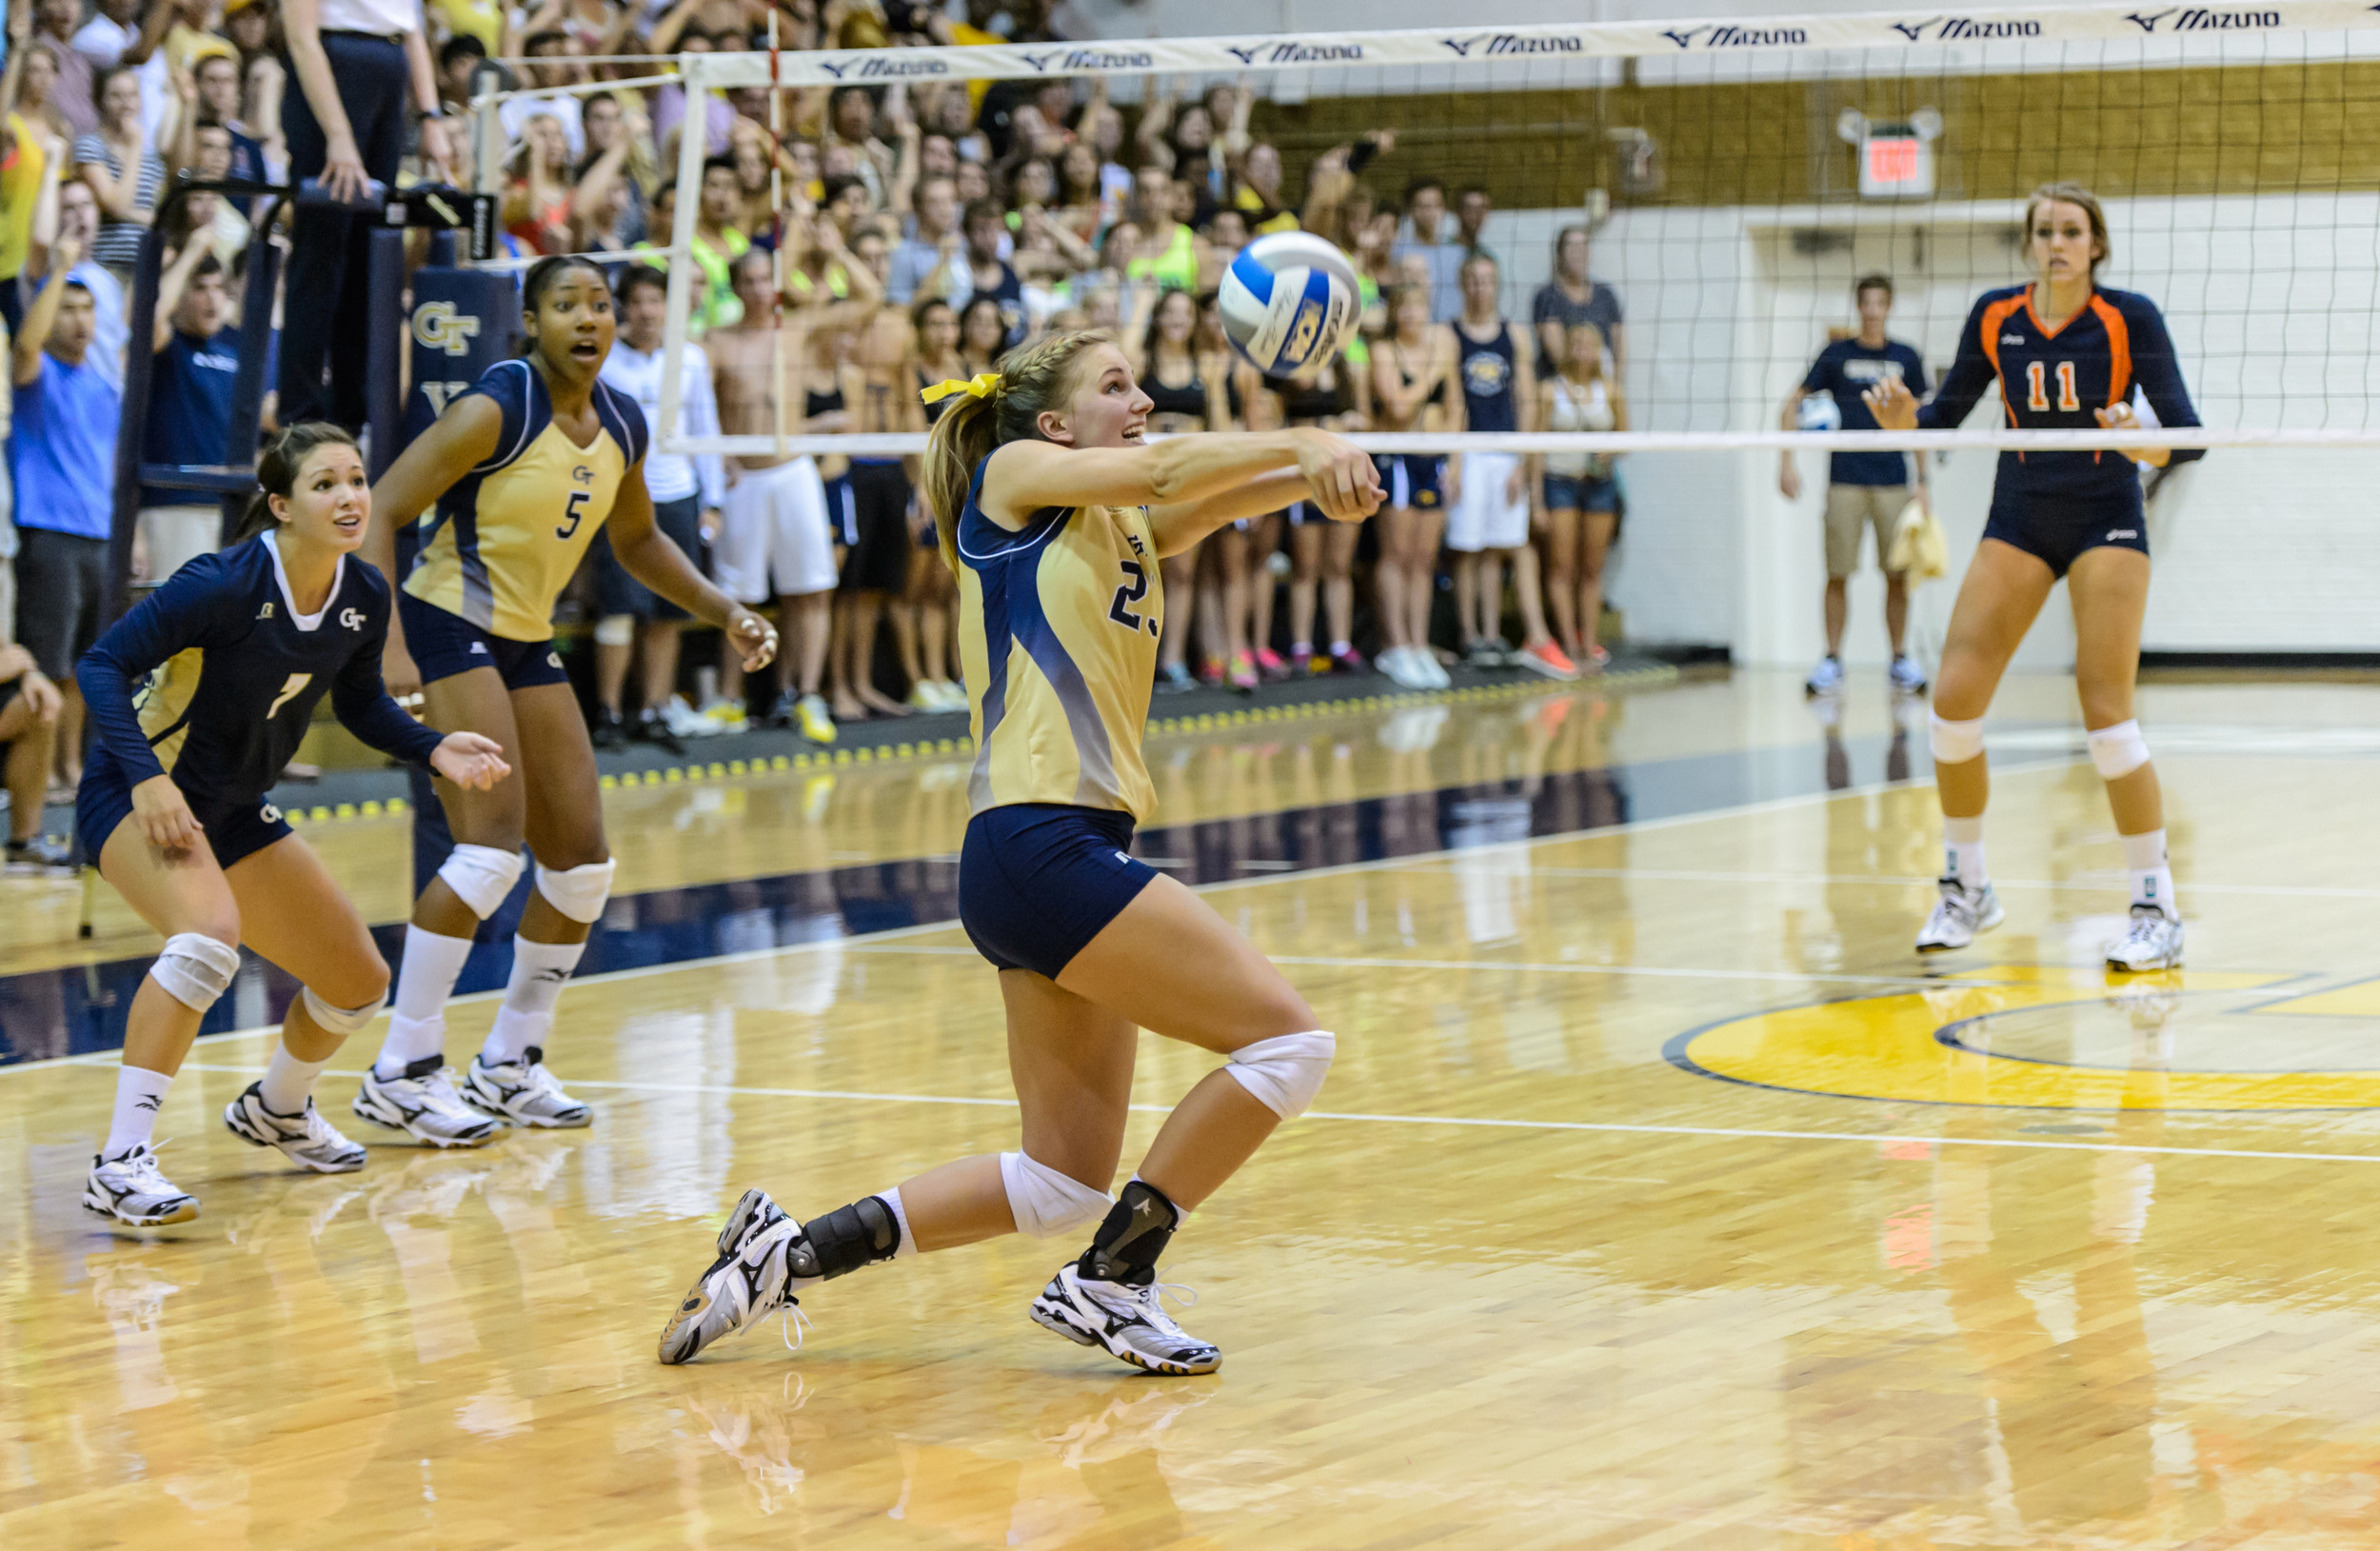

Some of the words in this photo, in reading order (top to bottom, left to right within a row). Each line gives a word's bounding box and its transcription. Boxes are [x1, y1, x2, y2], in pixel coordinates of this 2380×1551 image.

[2026, 361, 2081, 412] 11
[555, 489, 591, 541] 5
[266, 672, 313, 720] 7
